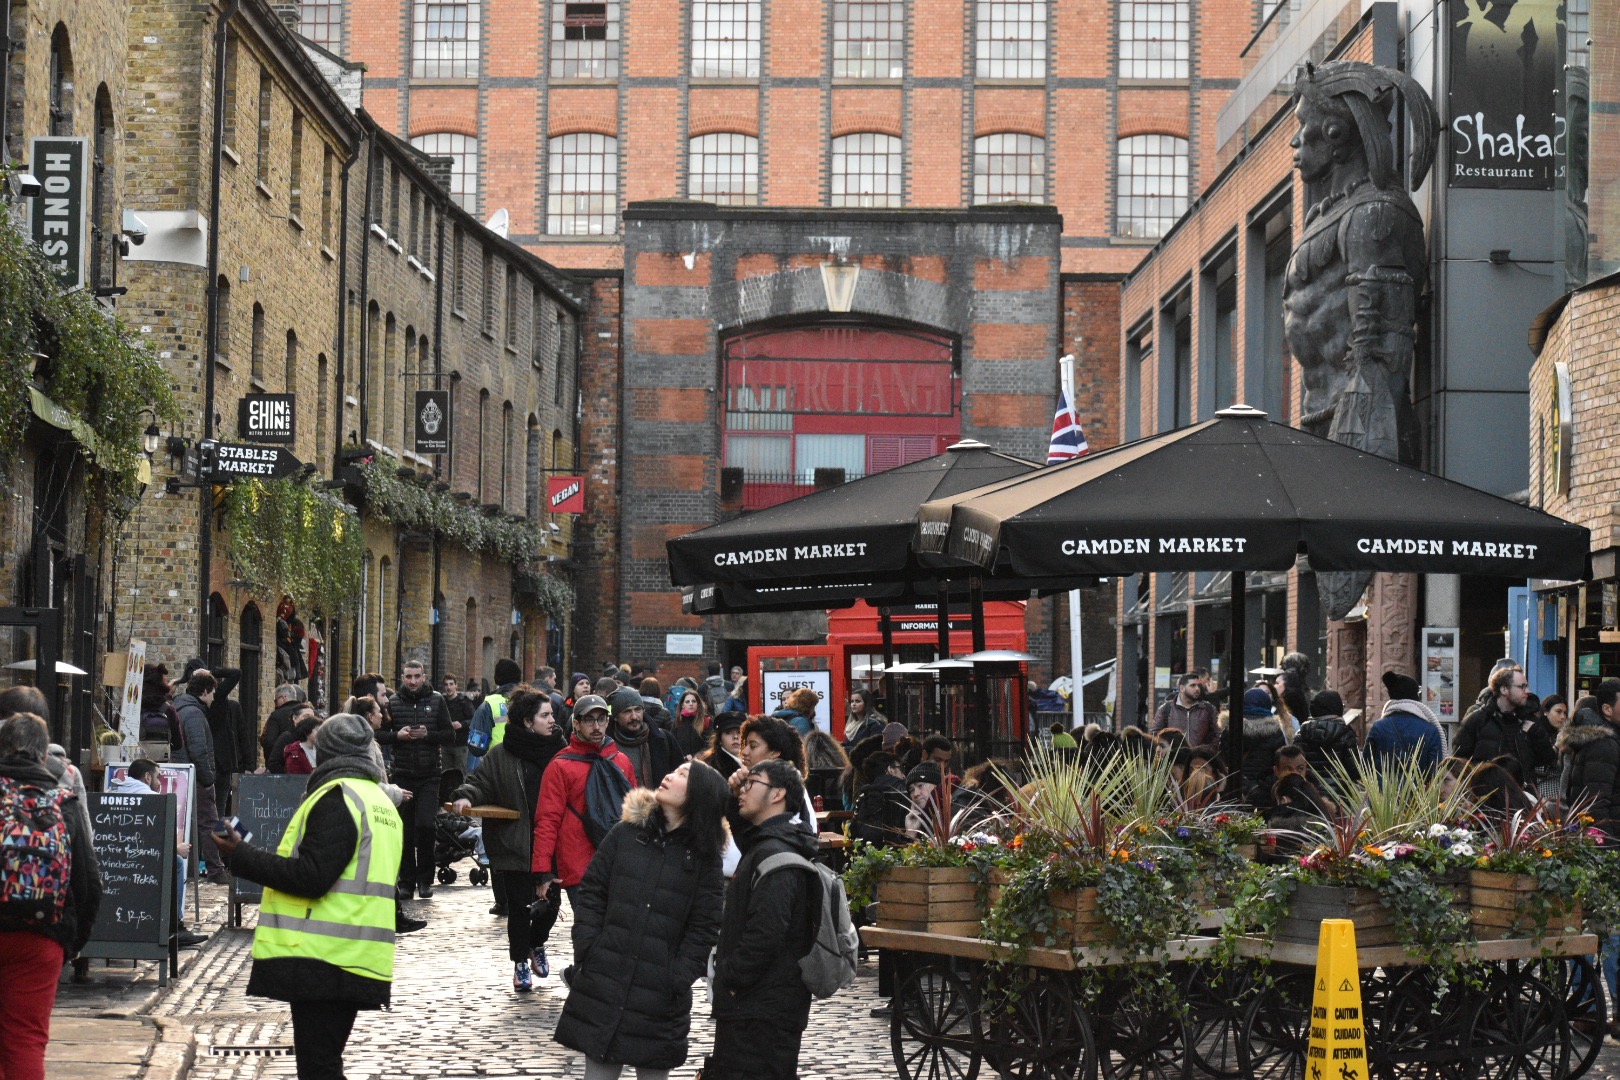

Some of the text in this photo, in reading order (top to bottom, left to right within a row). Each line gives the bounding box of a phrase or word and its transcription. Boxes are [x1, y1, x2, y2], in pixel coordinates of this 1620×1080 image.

[1453, 112, 1553, 162] Shaka
[1455, 164, 1534, 178] Restaurant
[42, 153, 71, 276] HONEST
[249, 401, 284, 415] CHIN
[249, 415, 284, 430] CHIN
[219, 446, 278, 461] STABLES
[218, 460, 275, 475] MARKET
[551, 481, 579, 506] VEGAN
[1061, 538, 1247, 556] CAMDEN MARKET
[1356, 538, 1538, 560] CAMDEN MARKET
[714, 543, 867, 566] CAMDEN MARKET
[901, 622, 953, 630] INFORMATN
[778, 681, 816, 690] GUEST
[100, 796, 143, 806] HONEST
[95, 813, 157, 826] CAMDEN
[1335, 1008, 1358, 1020] CAUTION
[1334, 1028, 1361, 1040] CUIDADO
[1333, 1048, 1363, 1060] ATTENTION
